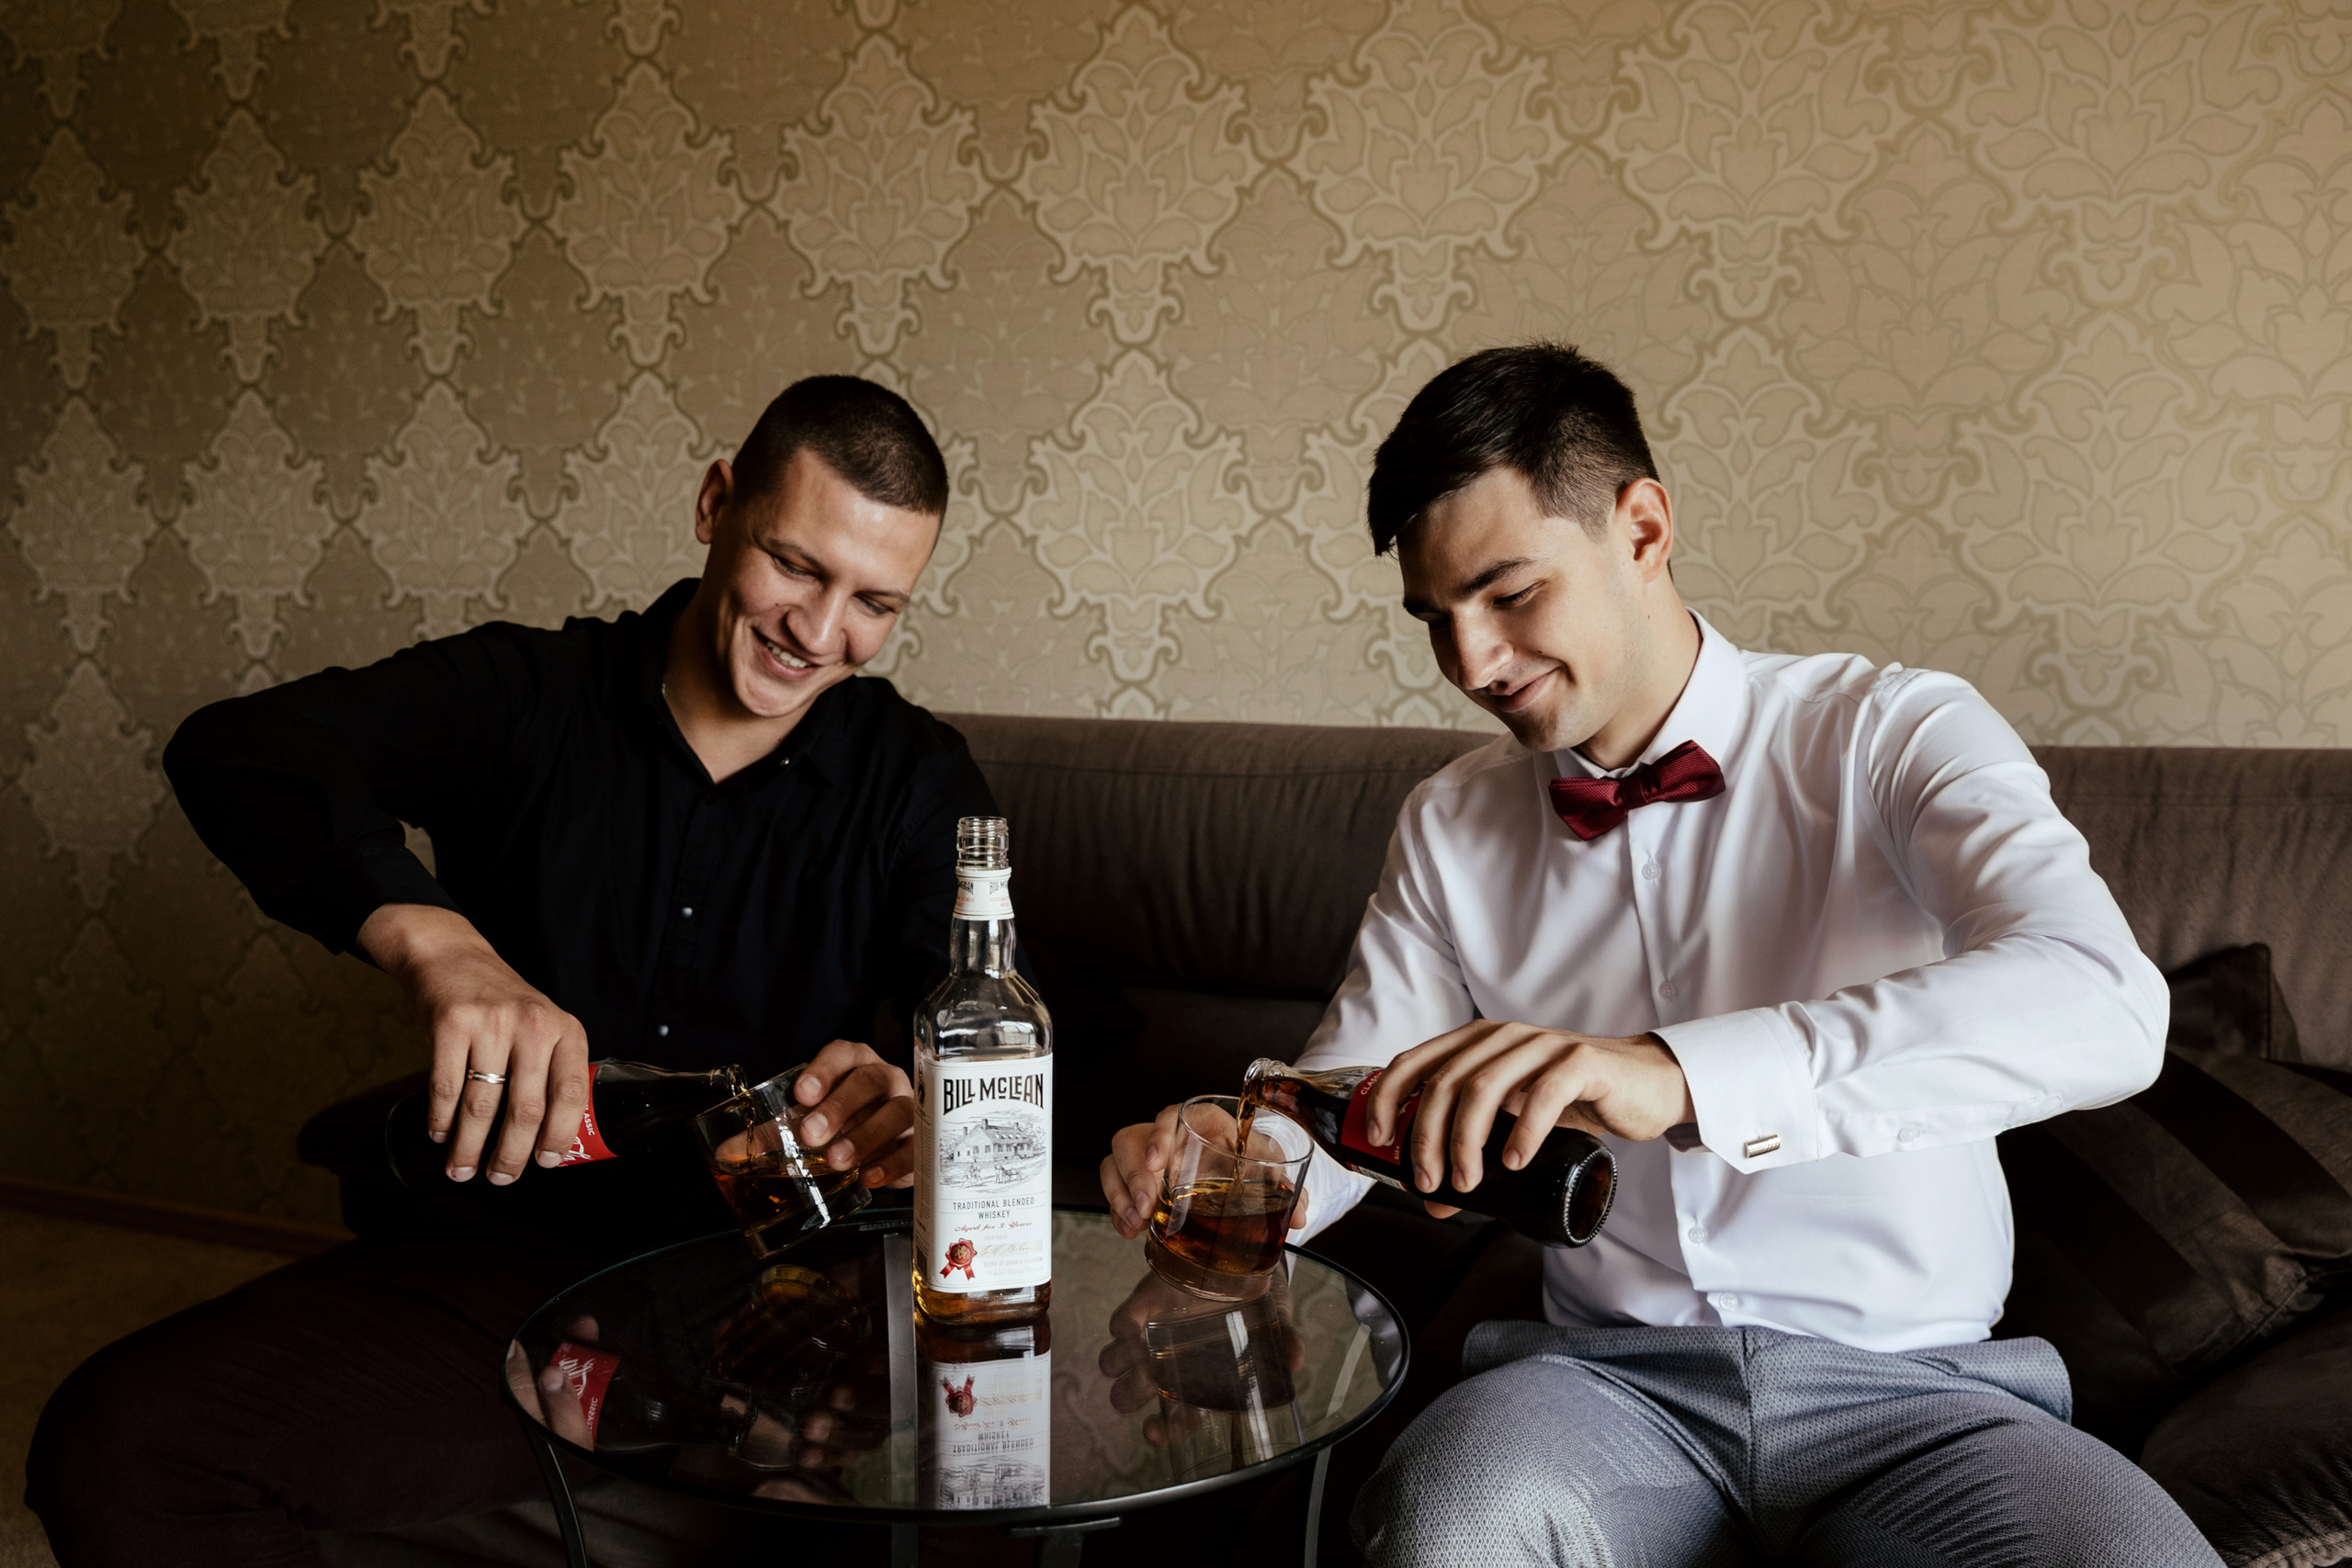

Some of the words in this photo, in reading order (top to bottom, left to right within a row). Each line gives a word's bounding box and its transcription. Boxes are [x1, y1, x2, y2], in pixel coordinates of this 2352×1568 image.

[1360, 1072, 1383, 1096] CLASS
[943, 1078, 976, 1115] BILL
[979, 1073, 1045, 1110] McLEAN
[583, 1104, 595, 1136] ASSIC
[953, 1200, 1000, 1210] TRADITIONAL
[1002, 1197, 1035, 1207] BLENDED
[978, 1210, 1011, 1219] WHISKEY
[954, 1224, 981, 1233] Aged
[980, 1224, 995, 1232] for
[1008, 1220, 1033, 1230] Years
